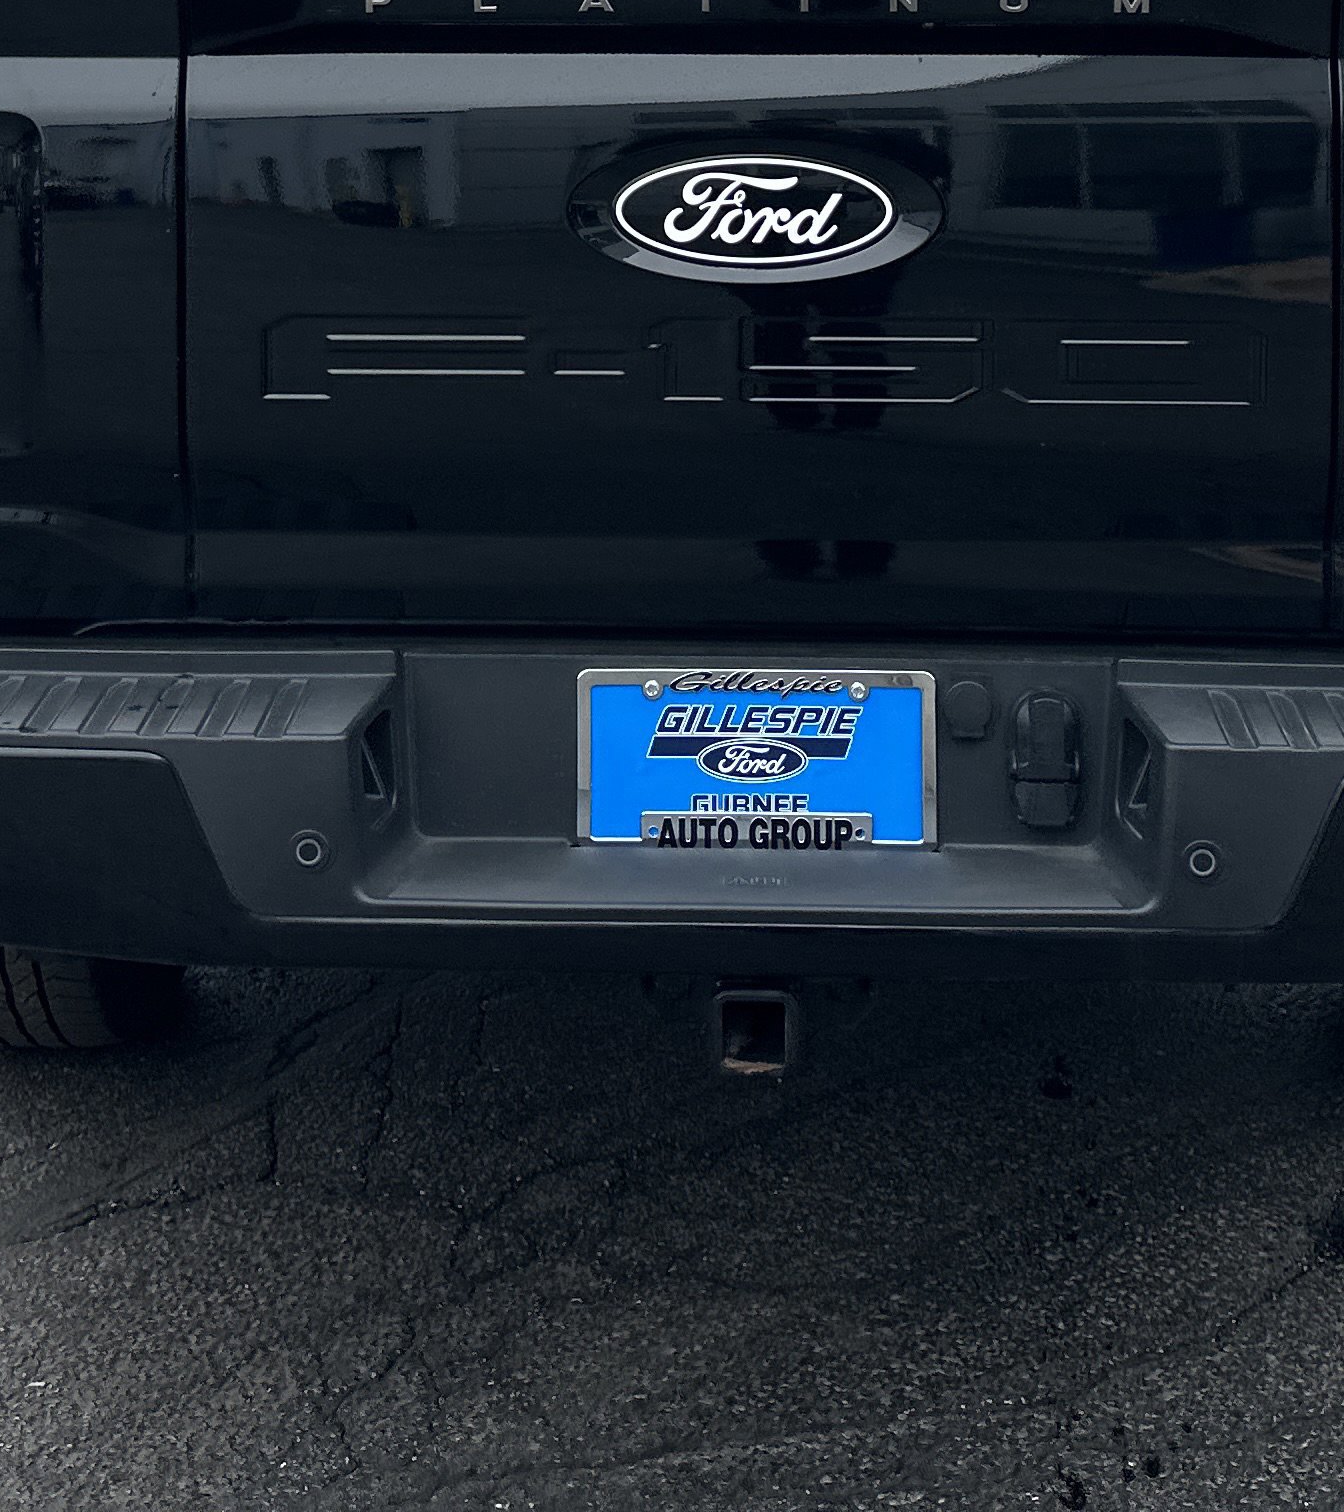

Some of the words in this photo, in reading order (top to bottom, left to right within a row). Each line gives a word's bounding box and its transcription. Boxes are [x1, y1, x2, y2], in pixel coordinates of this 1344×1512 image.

[663, 172, 843, 245] Ford
[262, 314, 1268, 405] F-150
[669, 670, 843, 700] Gillespie
[655, 704, 864, 736] GILLESPIE
[717, 744, 787, 775] Ford
[691, 793, 809, 813] GURNEE
[657, 816, 739, 849] AUTO
[749, 816, 854, 851] GROUP
